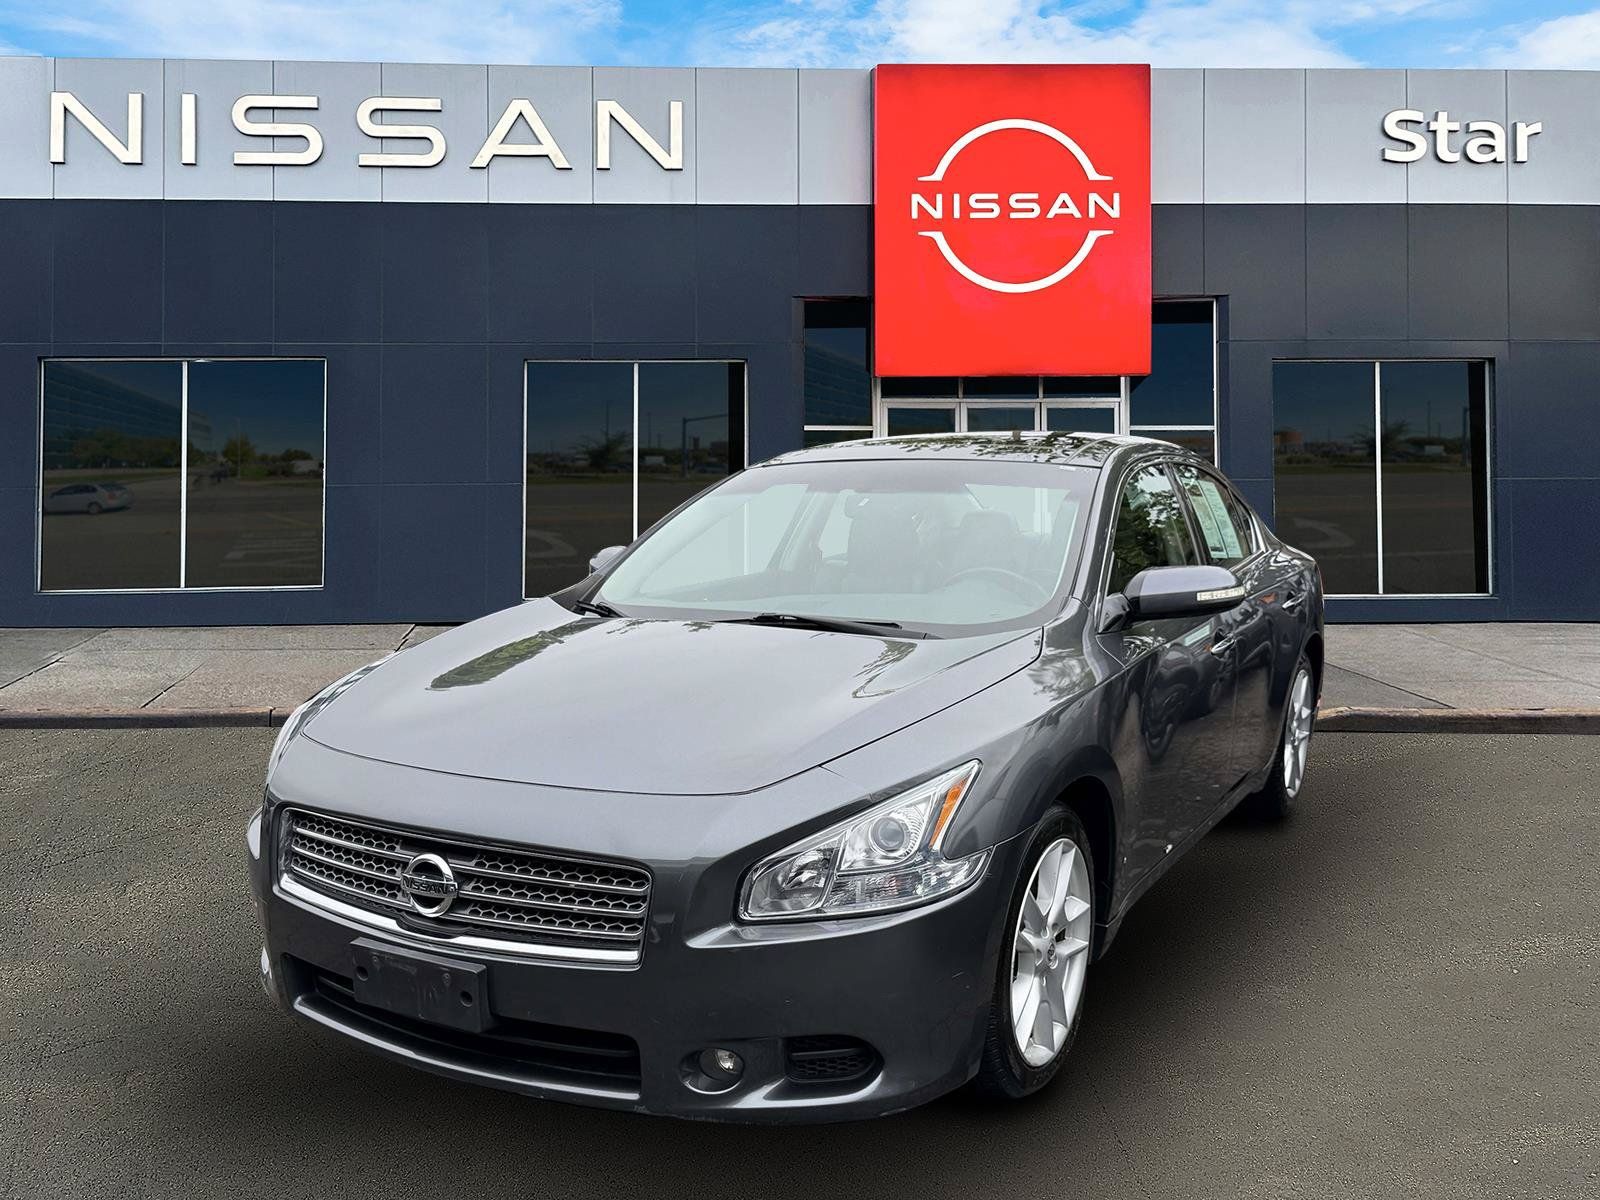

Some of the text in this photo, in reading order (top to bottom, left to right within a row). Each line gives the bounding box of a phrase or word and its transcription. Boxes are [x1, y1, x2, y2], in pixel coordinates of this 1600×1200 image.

[50, 91, 684, 171] NISSAN
[1382, 108, 1543, 164] Star
[911, 191, 1121, 220] NISSAN
[403, 876, 448, 895] NISSAN
